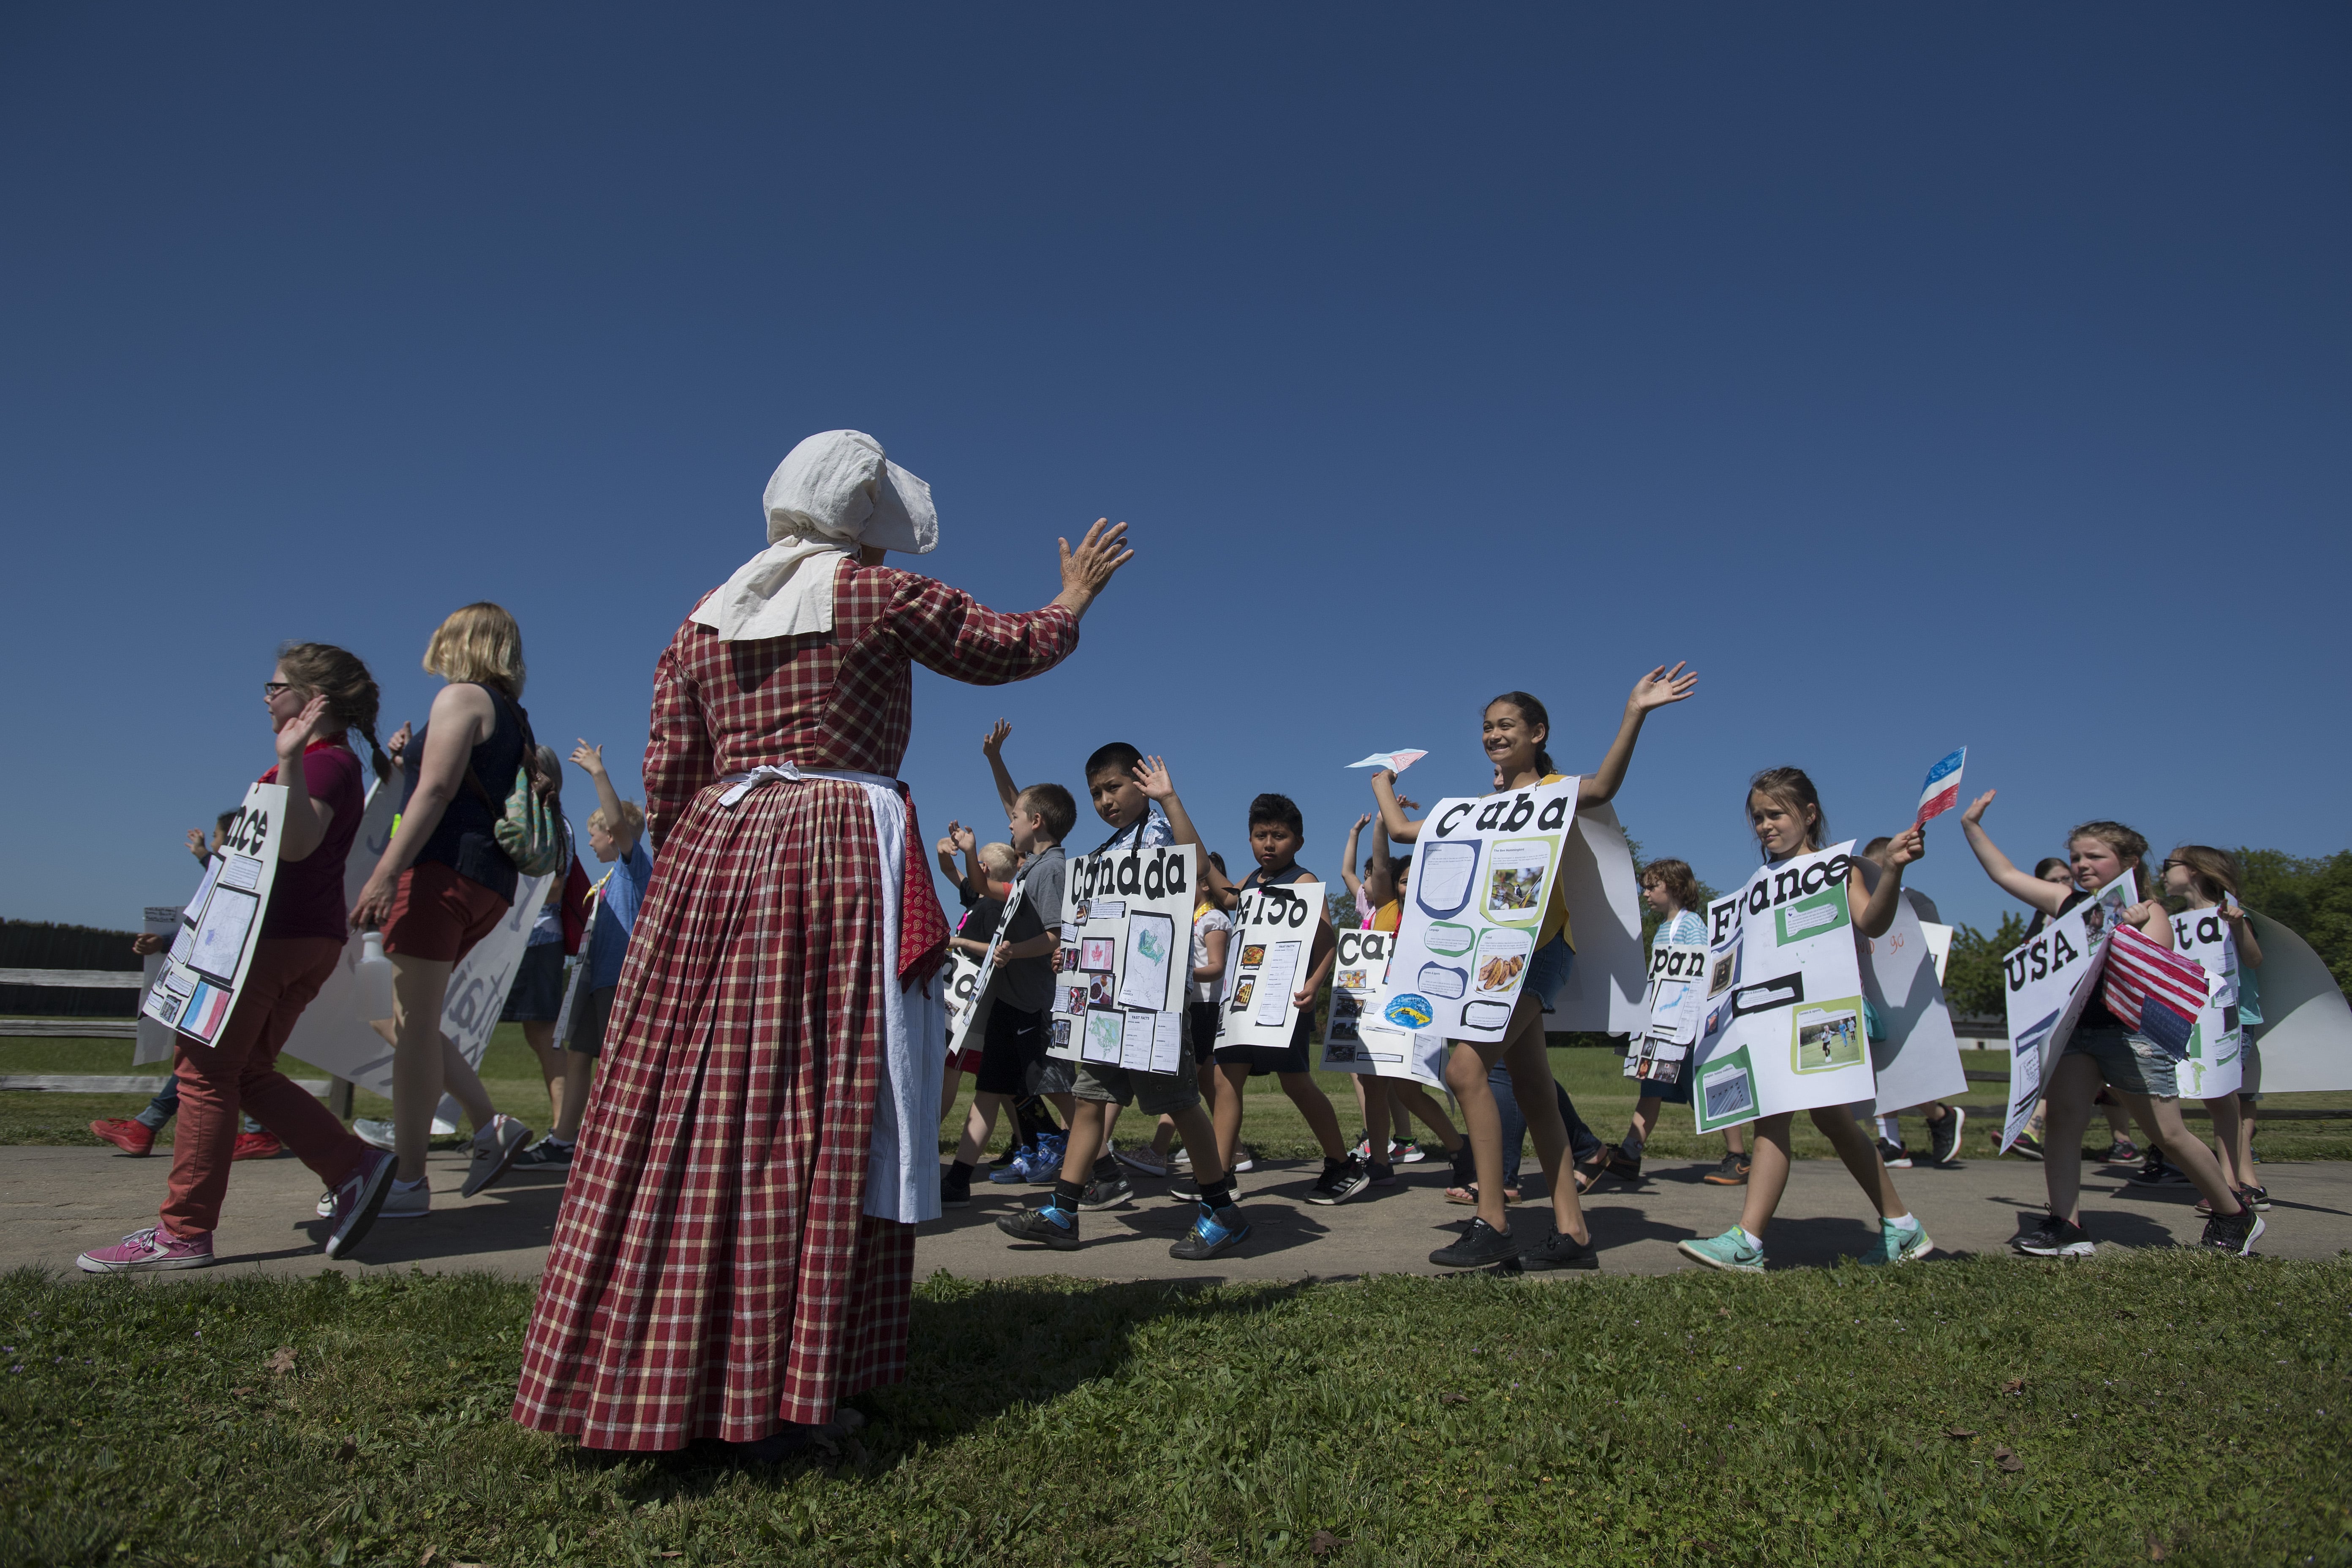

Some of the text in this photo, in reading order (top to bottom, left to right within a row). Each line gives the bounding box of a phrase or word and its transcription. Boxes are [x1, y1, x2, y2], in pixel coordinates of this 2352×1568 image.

[1436, 792, 1568, 838] Cuba
[1071, 848, 1187, 906] Canada
[1711, 854, 1850, 947] France
[1649, 949, 1705, 979] pan
[2004, 929, 2079, 992] USA
